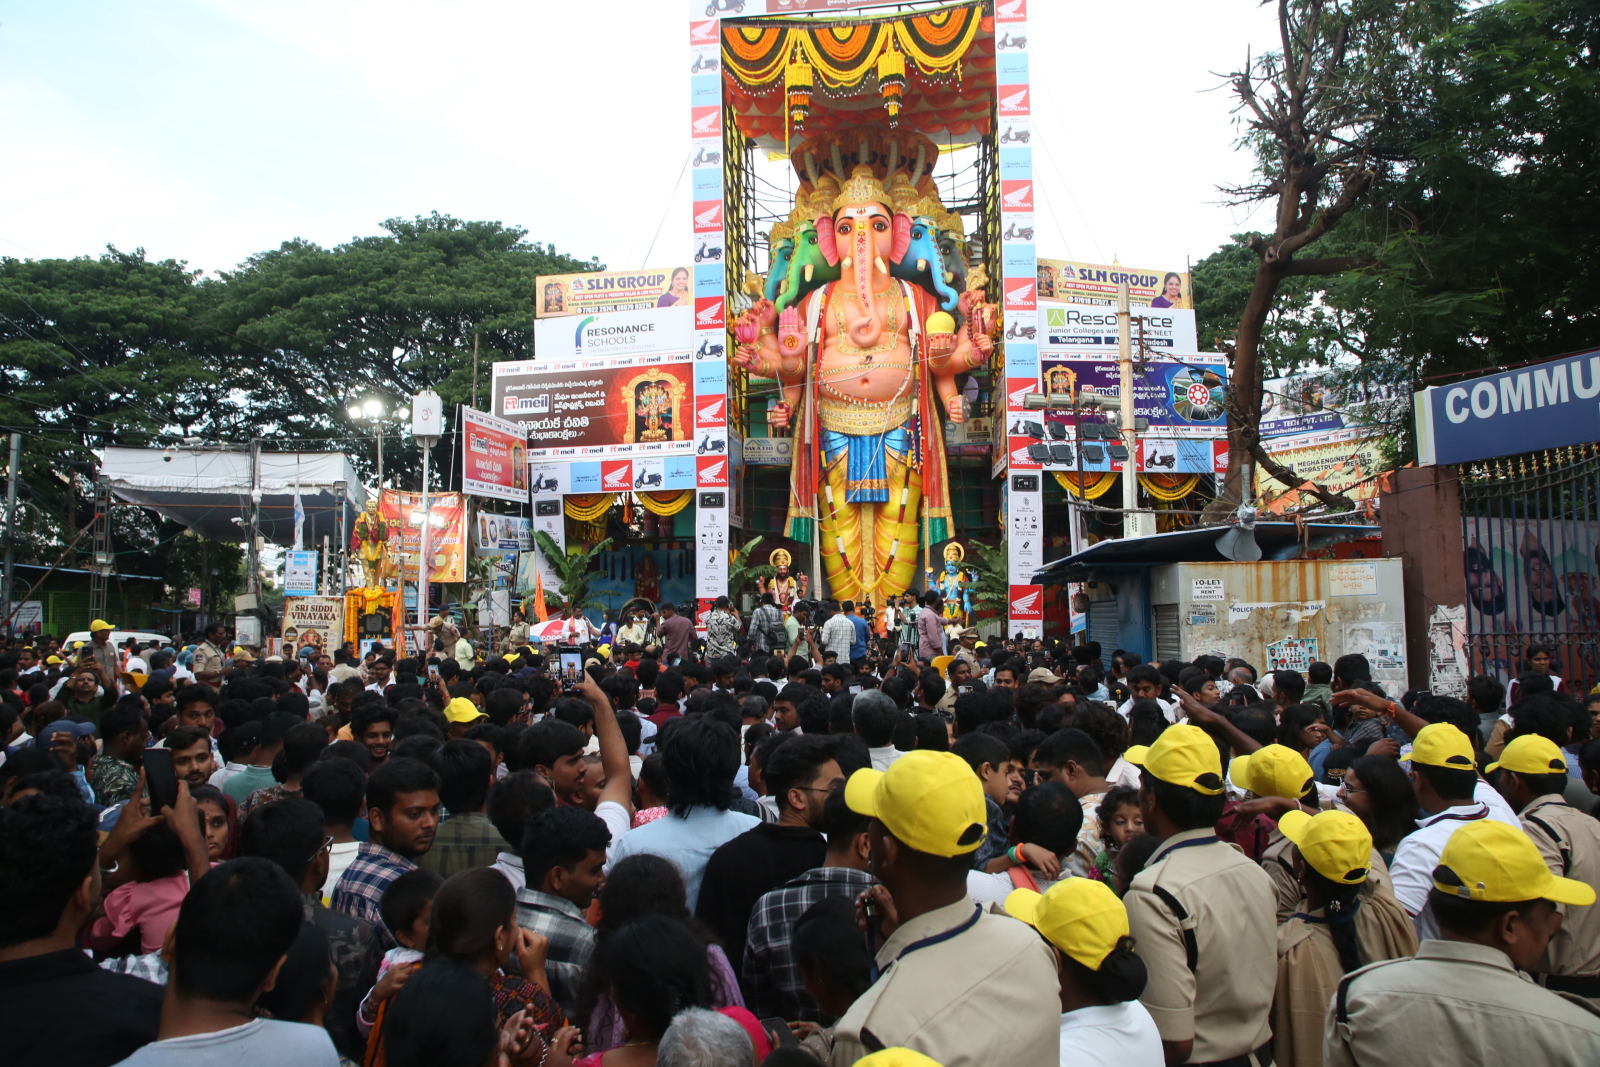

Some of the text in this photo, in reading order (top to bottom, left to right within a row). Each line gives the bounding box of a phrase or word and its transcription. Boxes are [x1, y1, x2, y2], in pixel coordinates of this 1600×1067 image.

[587, 277, 614, 290] SLN
[617, 274, 666, 289] GROUP
[1079, 268, 1107, 283] SLN
[1110, 272, 1158, 288] GROUP
[1066, 310, 1172, 328] Resoance
[587, 323, 655, 337] RESONANCE
[587, 336, 636, 347] SCHOOLS
[1445, 356, 1600, 424] COMMU
[520, 396, 548, 408] meil
[295, 604, 308, 612] SRI
[291, 612, 336, 620] VINAYAKA
